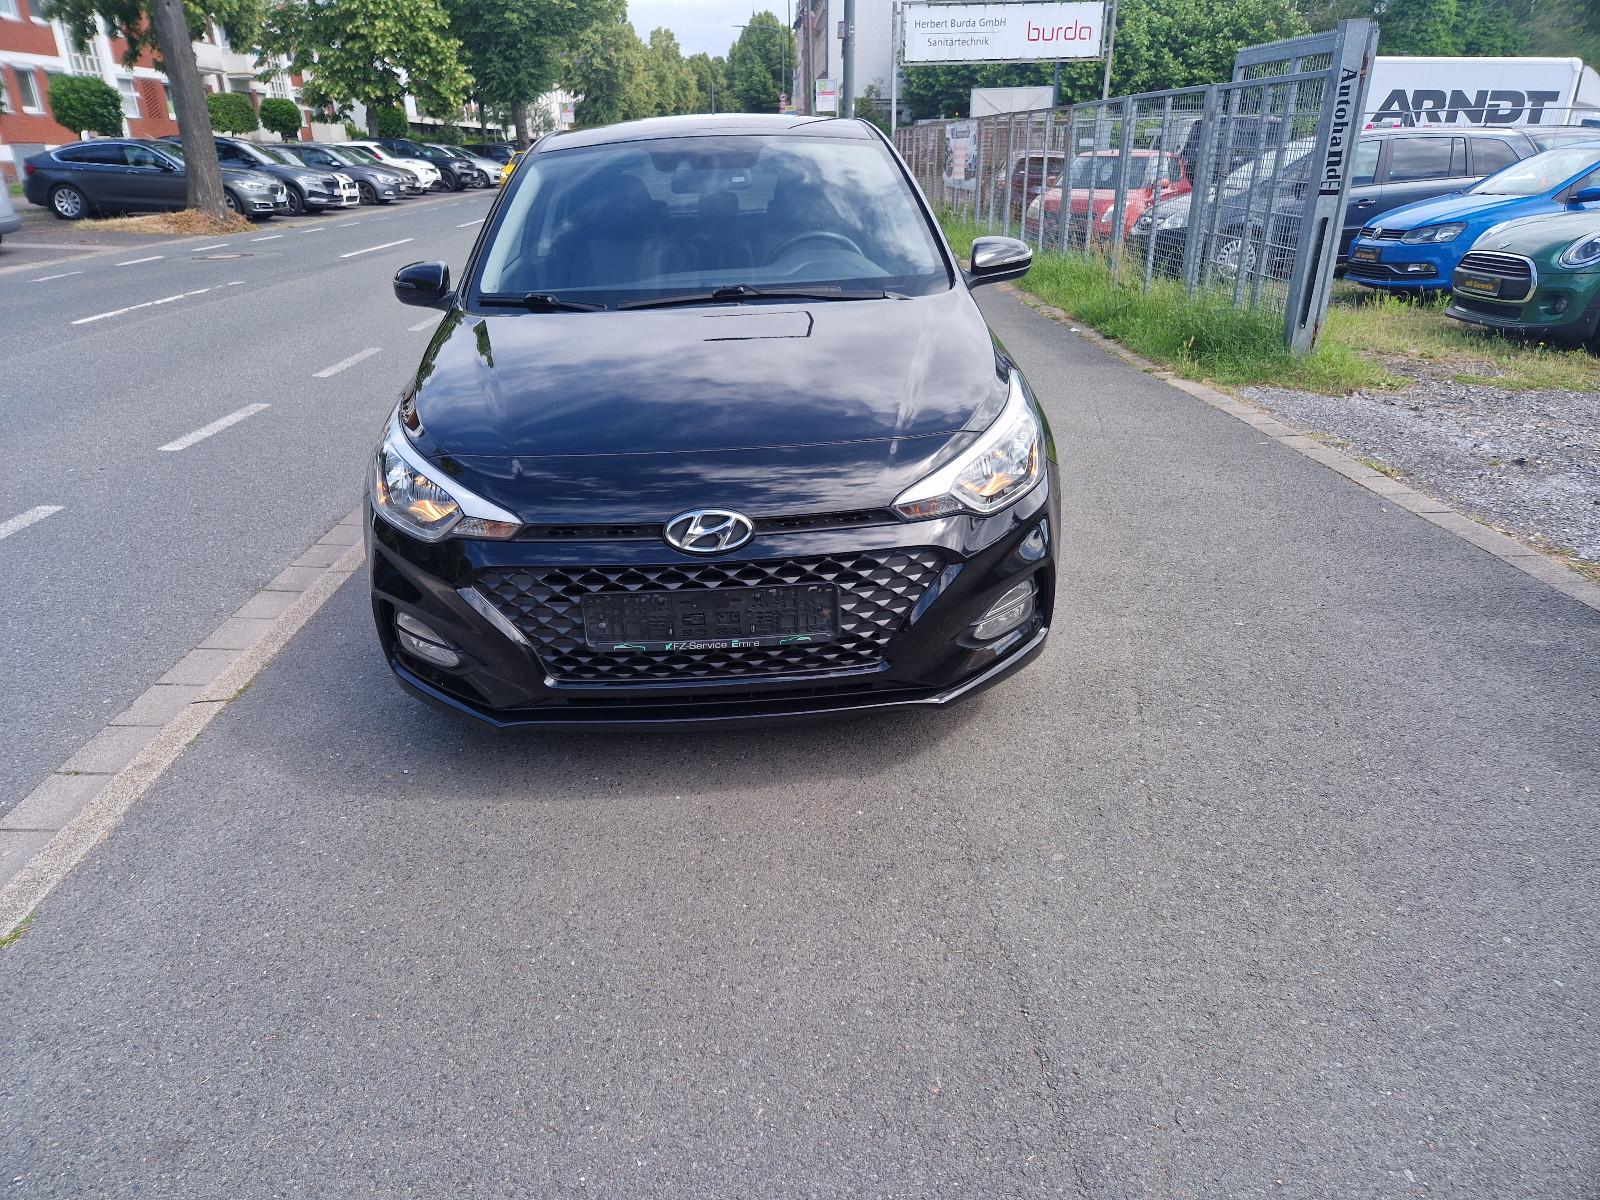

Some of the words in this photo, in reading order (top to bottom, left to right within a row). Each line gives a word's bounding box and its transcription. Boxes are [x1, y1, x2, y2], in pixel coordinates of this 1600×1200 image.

[914, 19, 948, 28] Herbert
[950, 18, 976, 28] Burda
[979, 17, 1007, 27] GmbH
[1027, 20, 1092, 42] burda
[927, 36, 990, 47] Sanitärtechnik
[1369, 89, 1560, 127] ARNDT
[664, 641, 728, 651] KFZ-Service
[731, 639, 760, 648] Emre
